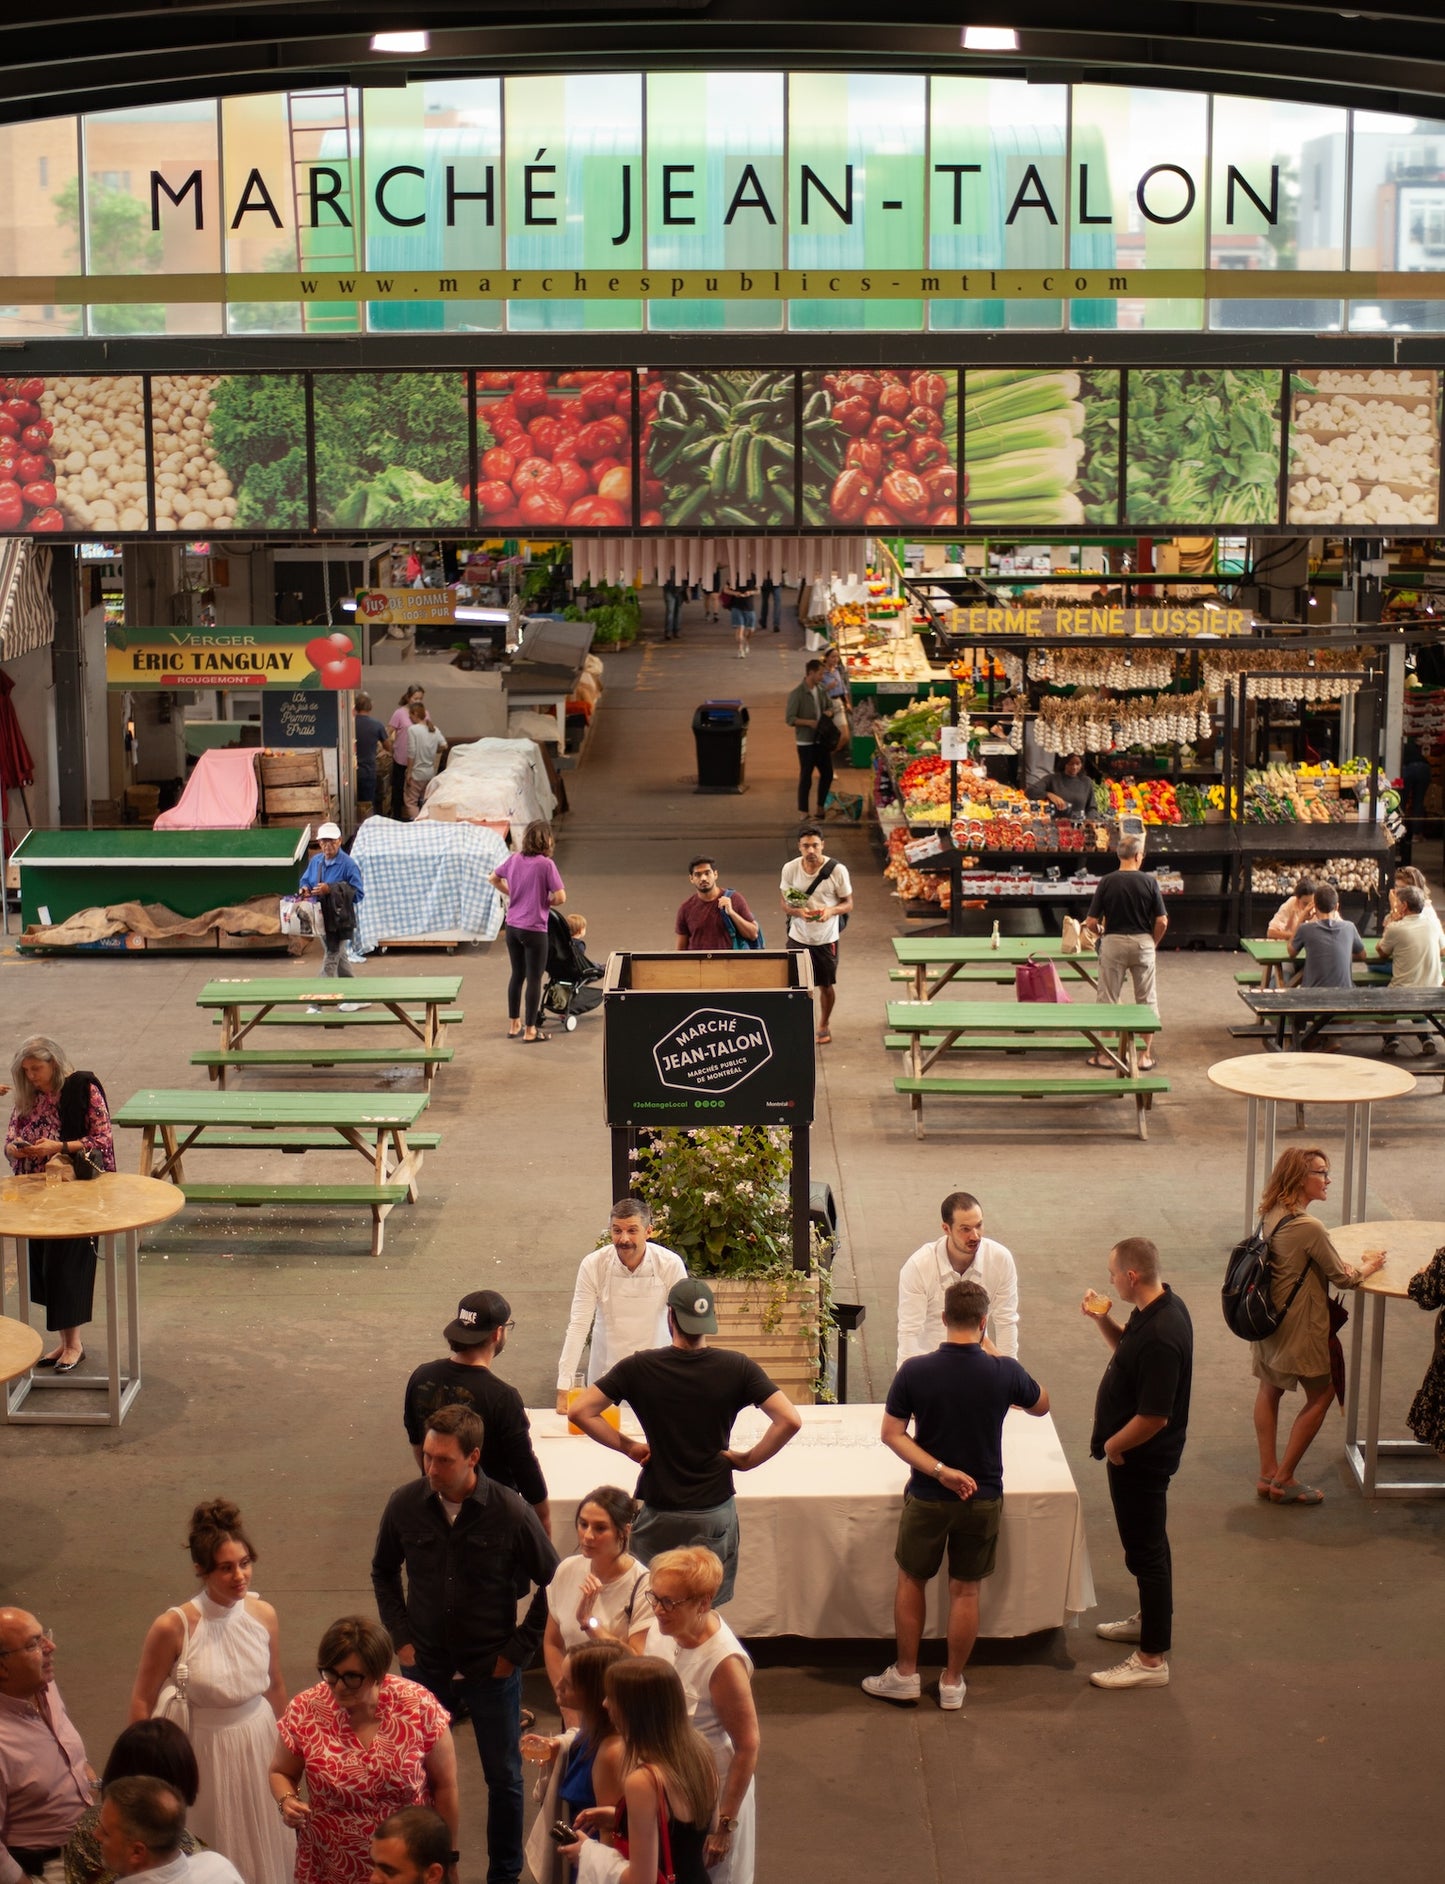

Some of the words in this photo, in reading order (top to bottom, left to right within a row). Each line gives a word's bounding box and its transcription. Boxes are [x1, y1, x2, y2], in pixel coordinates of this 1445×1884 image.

[150, 148, 558, 231] MARCHÉ
[611, 164, 1280, 246] JEAN-TALON
[301, 271, 1128, 298] www.marchespublics-mtl.com
[365, 600, 385, 613] JUS
[389, 598, 404, 610] DE
[408, 592, 449, 608] POMME
[431, 607, 450, 617] PUR
[951, 608, 1042, 633] FERME
[1134, 609, 1245, 634] LUSSIER
[133, 649, 184, 671] ÉRIC
[190, 653, 293, 671] TANGUAY
[177, 676, 250, 684] ROUGEMONT
[281, 711, 316, 723] Pomme
[286, 723, 315, 736] Frais
[675, 1018, 737, 1047] MARCHÉ
[662, 1031, 763, 1071] JEAN-TALON
[687, 1064, 719, 1078] MARCHÉS
[720, 1057, 748, 1070] PUBLICS
[696, 1076, 706, 1084] DE
[707, 1067, 743, 1081] MONTRÉAL
